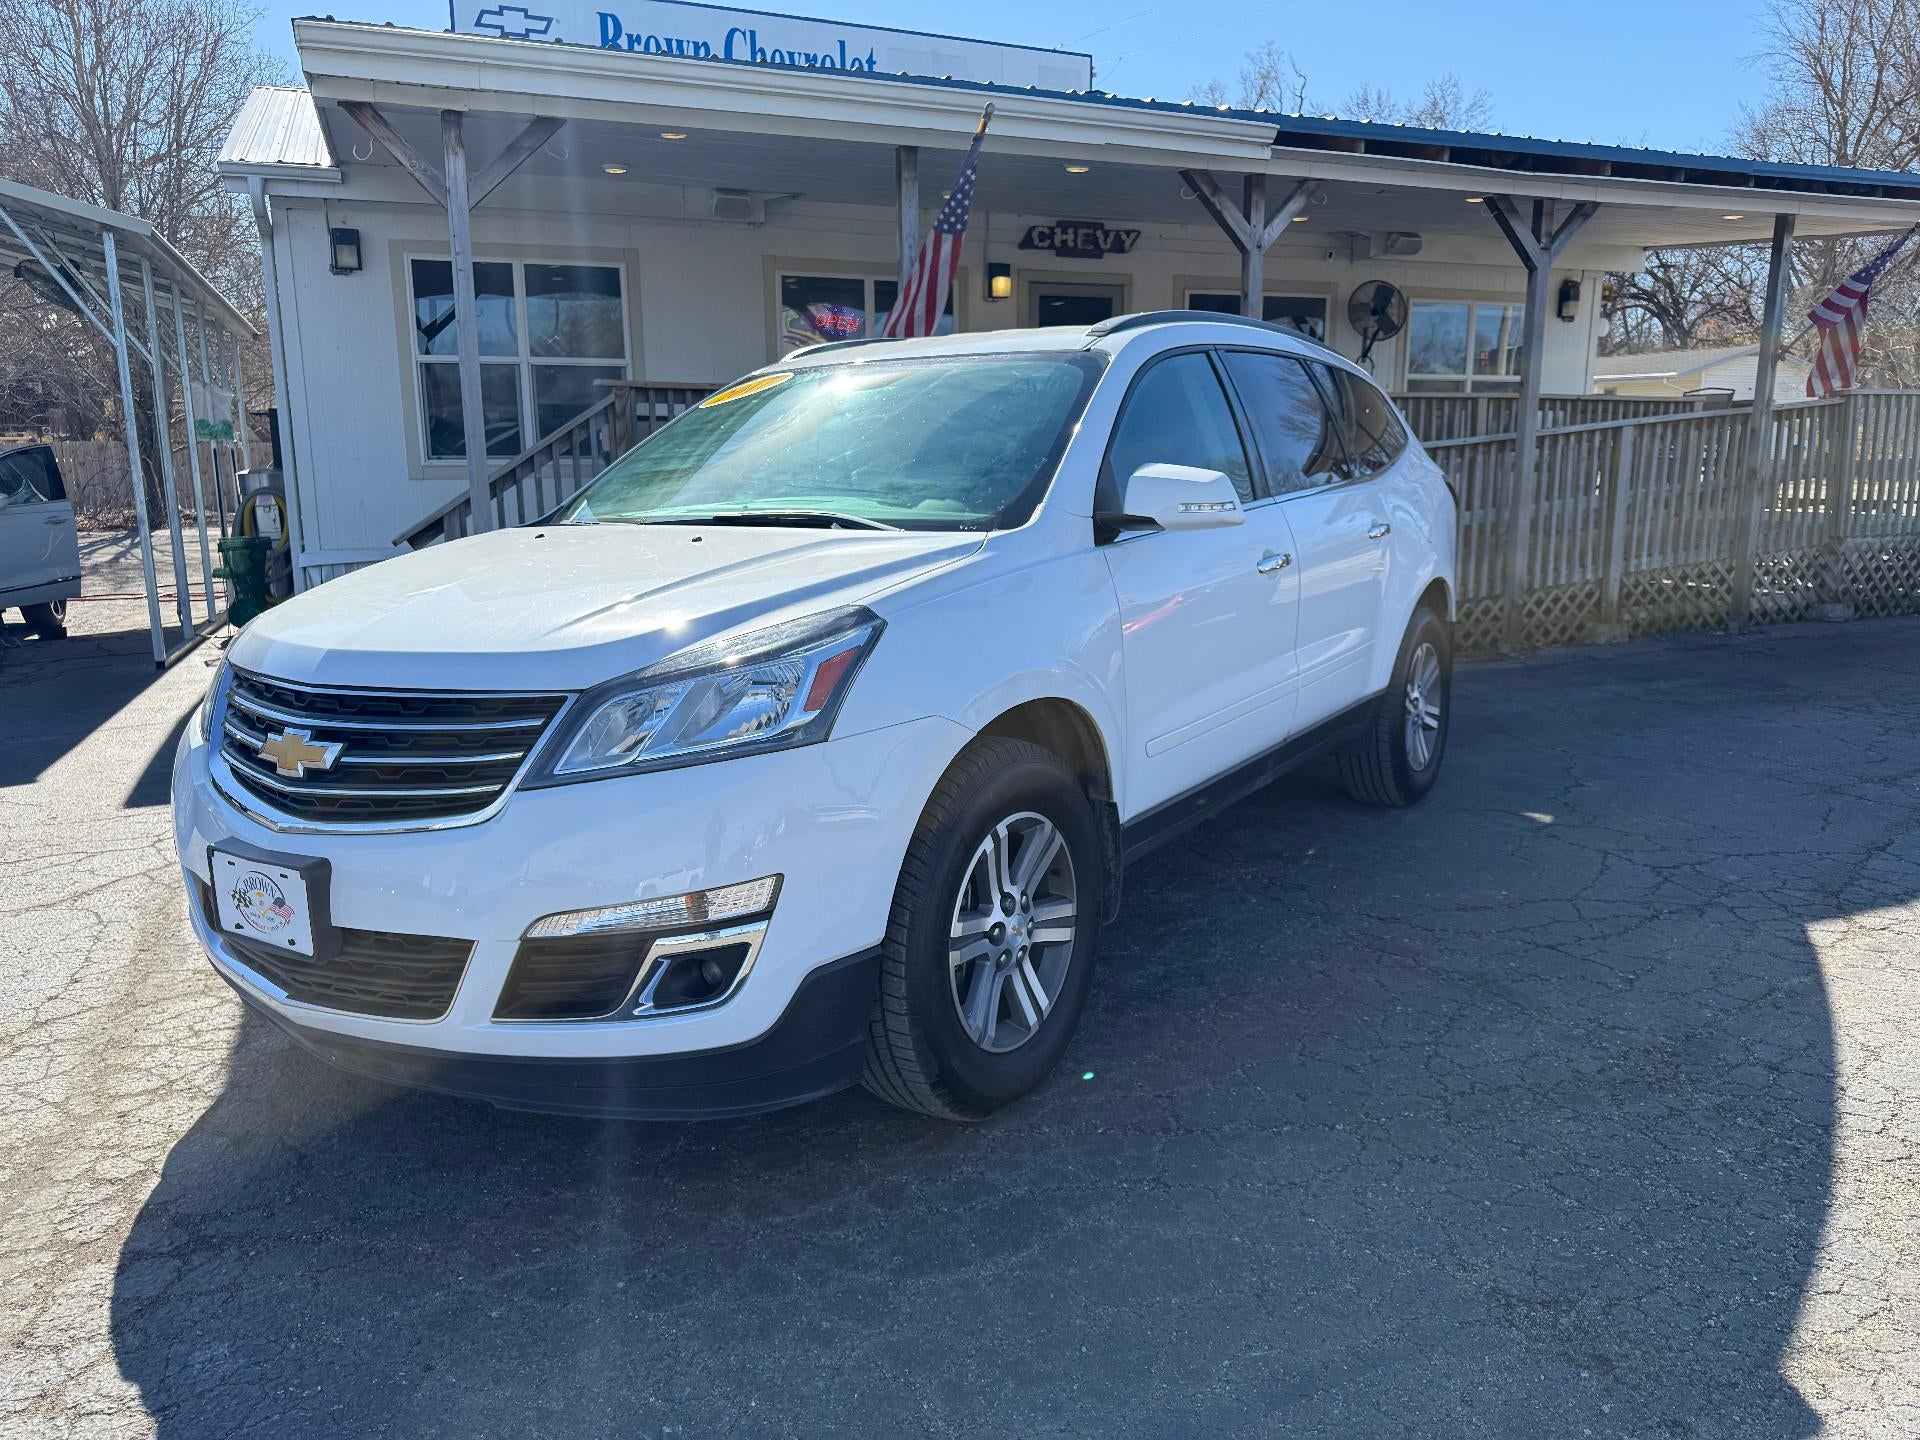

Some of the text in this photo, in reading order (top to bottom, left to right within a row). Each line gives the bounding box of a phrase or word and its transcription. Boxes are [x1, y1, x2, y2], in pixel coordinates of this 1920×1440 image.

[1031, 226, 1138, 252] CHEVY
[815, 313, 860, 333] OPEN
[242, 876, 278, 900] BROWN
